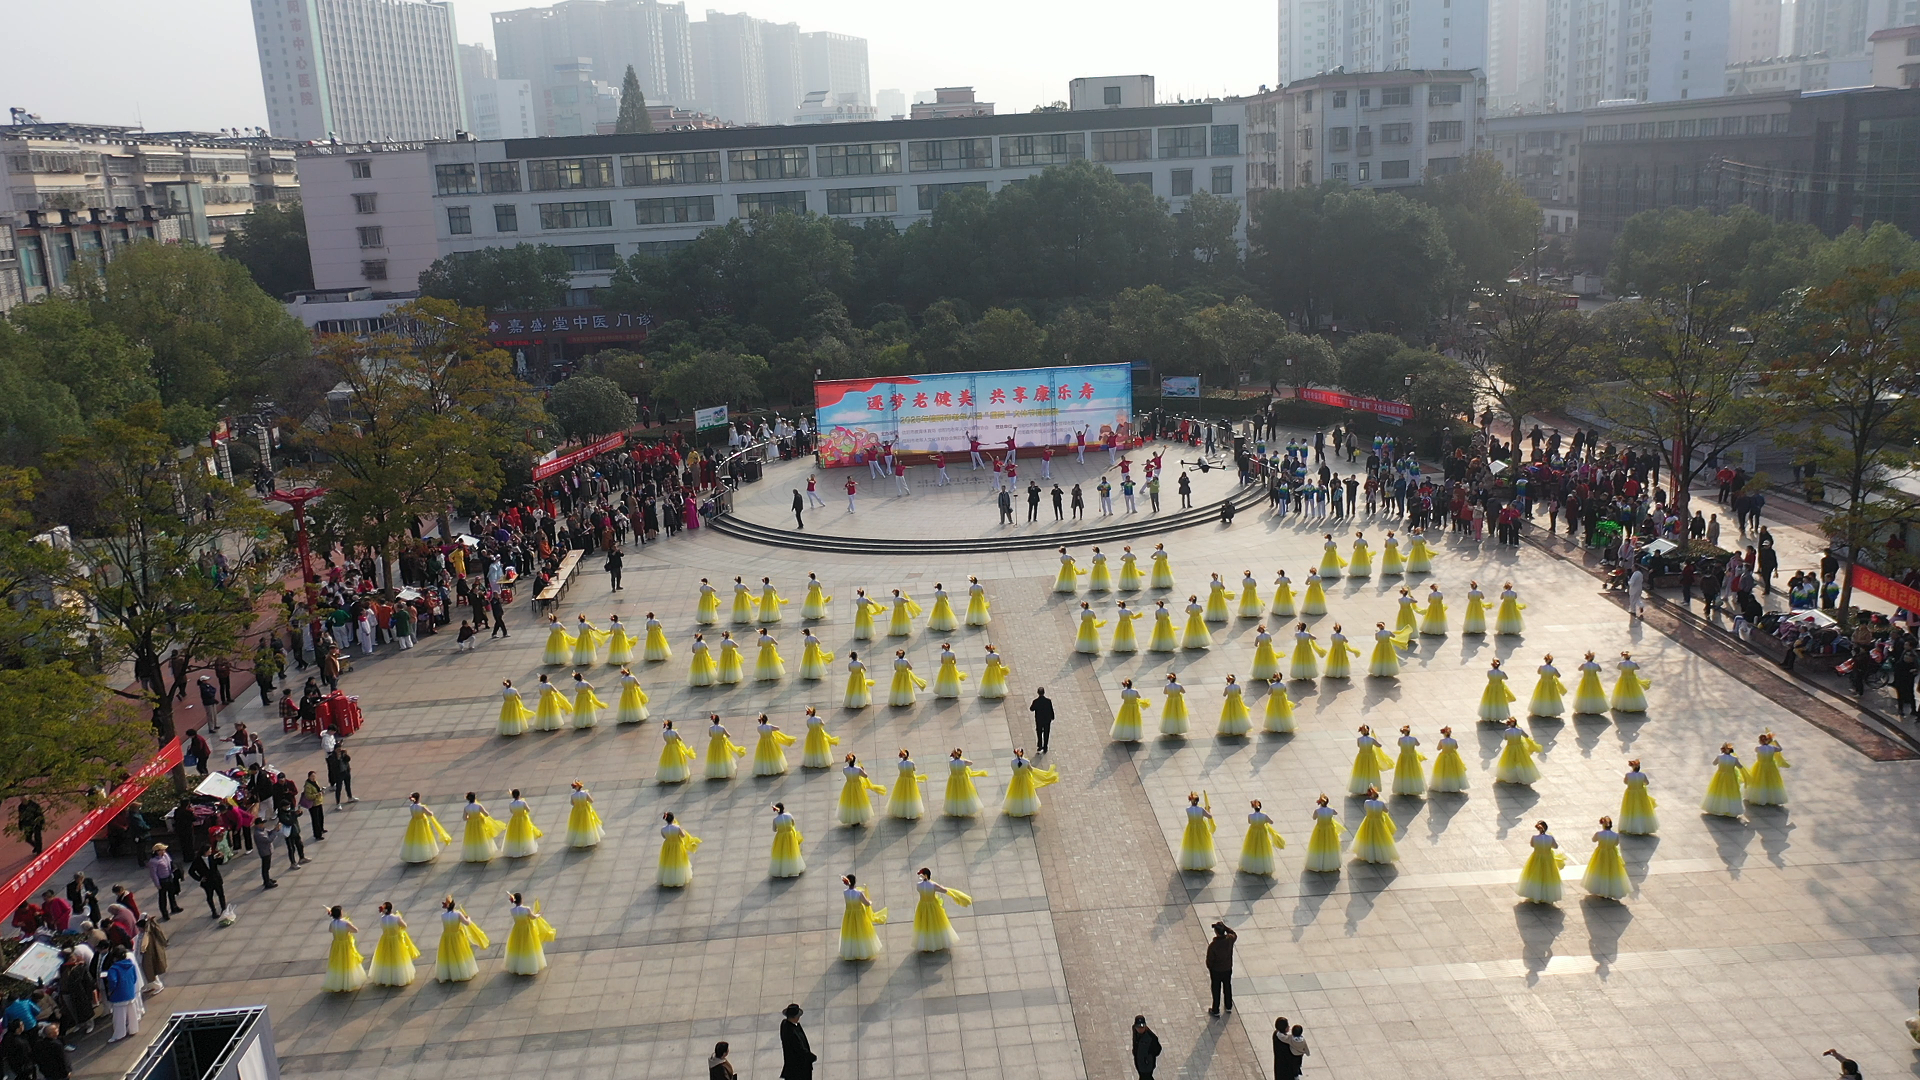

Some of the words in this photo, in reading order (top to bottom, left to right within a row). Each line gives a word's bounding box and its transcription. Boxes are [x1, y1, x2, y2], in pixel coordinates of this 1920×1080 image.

[287, 0, 313, 106] 阳市中心医院
[507, 313, 654, 335] 嘉盛堂中医门诊
[866, 388, 975, 412] 逐梦老健美
[989, 382, 1095, 405] 共享康乐寿
[1861, 572, 1920, 610] 保护好自己的
